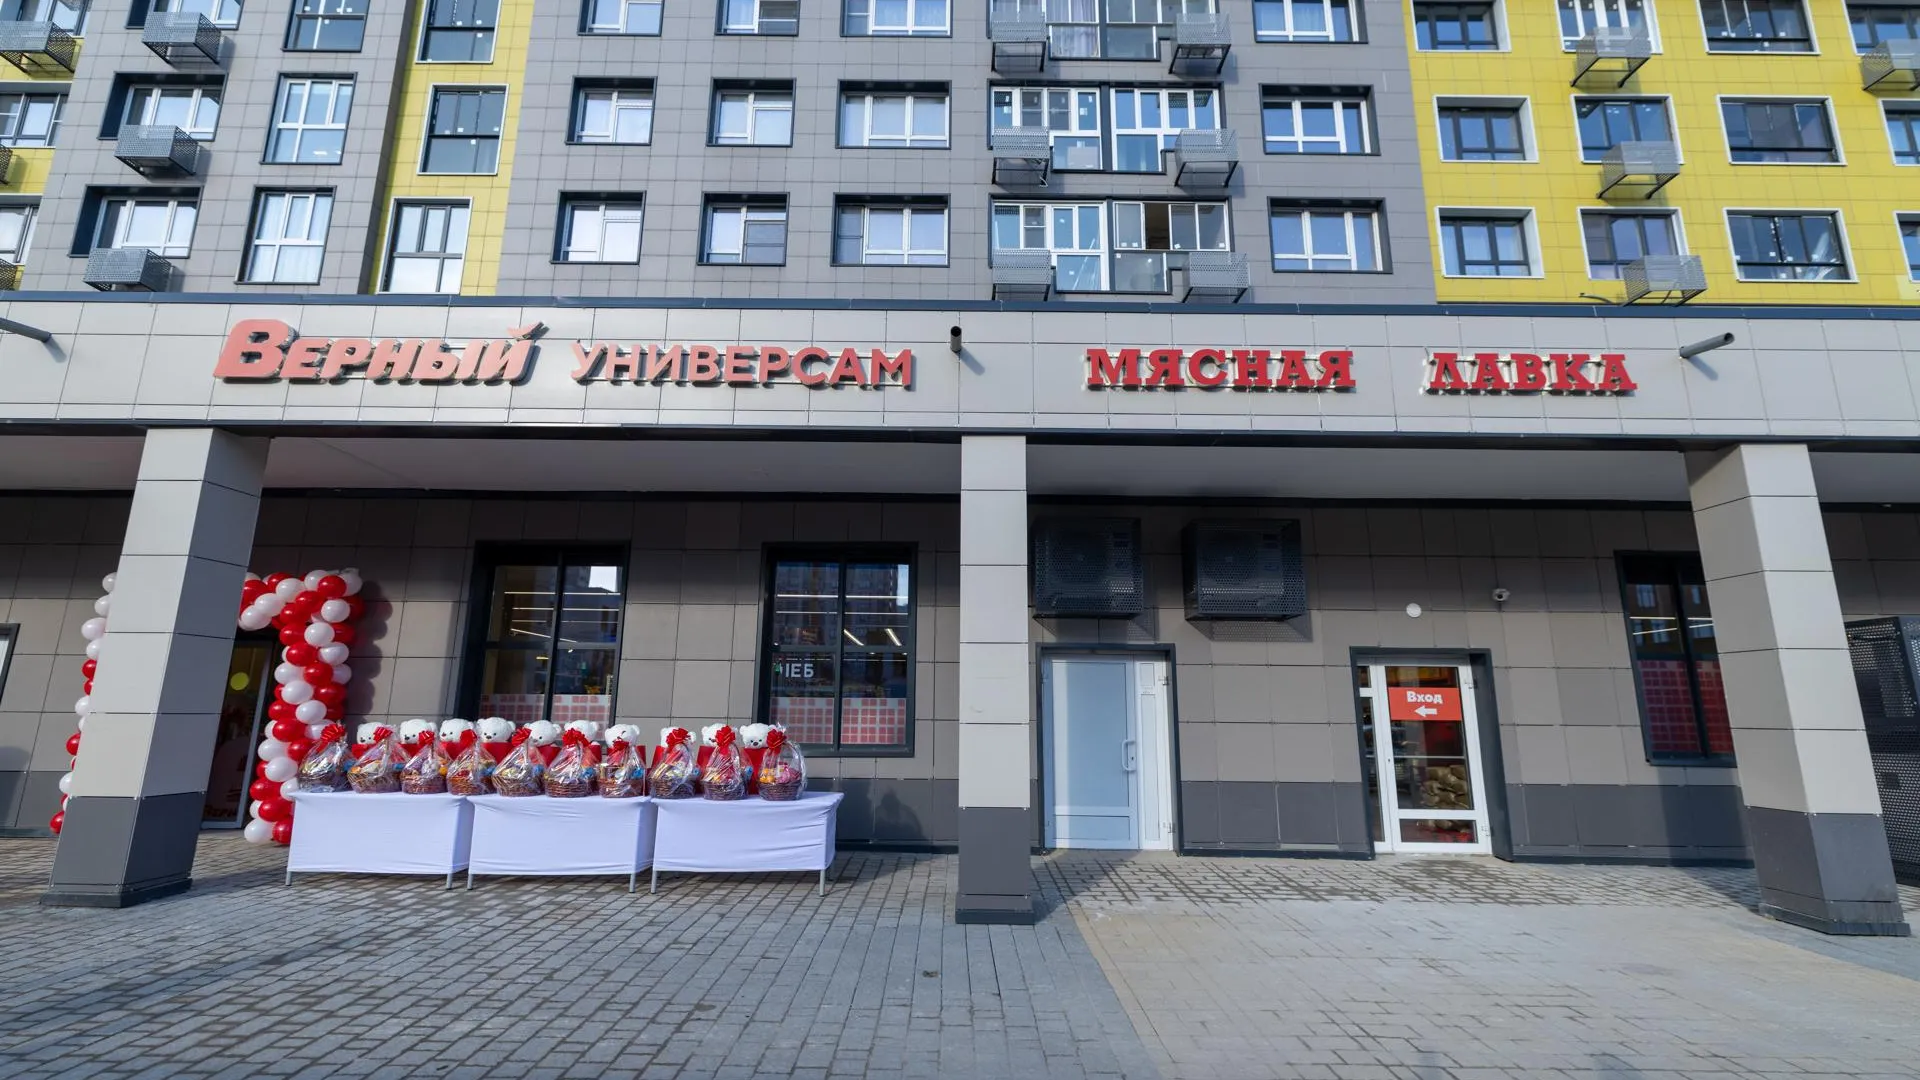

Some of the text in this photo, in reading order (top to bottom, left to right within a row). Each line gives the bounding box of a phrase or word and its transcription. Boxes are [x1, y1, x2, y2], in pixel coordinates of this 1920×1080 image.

[571, 341, 913, 387] УНИВЕРСАМ
[1086, 347, 1638, 393] МЯСНАЯ ЛАВКА
[1407, 690, 1443, 704] Вход
